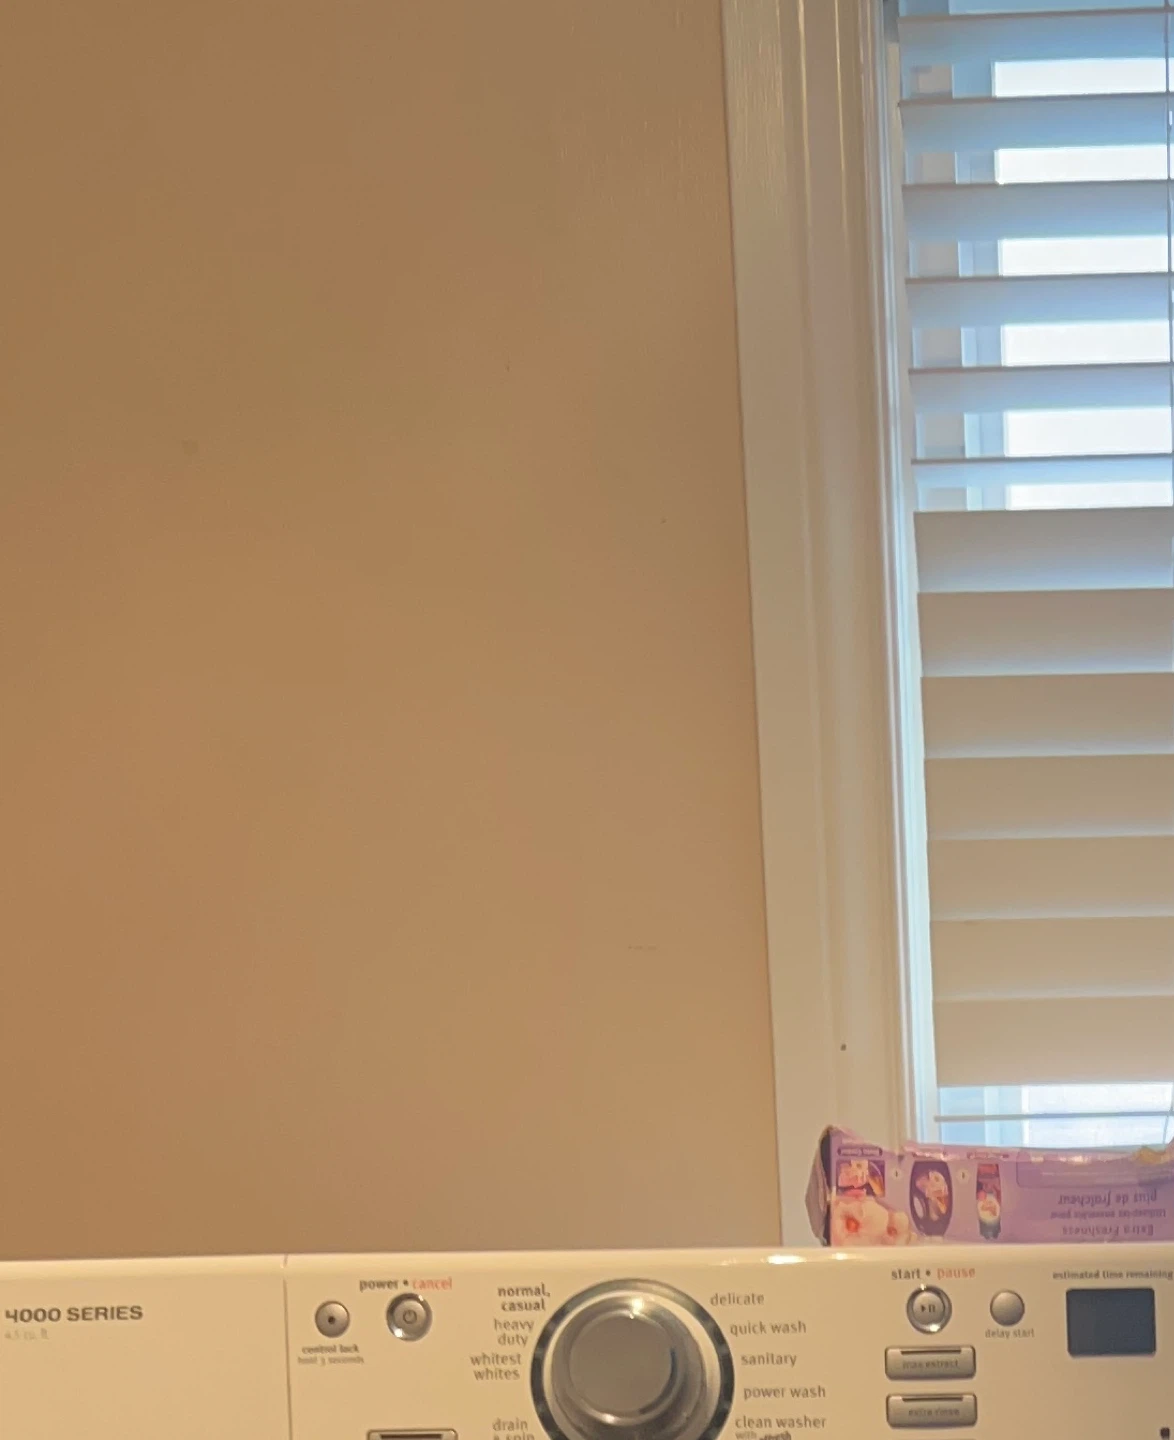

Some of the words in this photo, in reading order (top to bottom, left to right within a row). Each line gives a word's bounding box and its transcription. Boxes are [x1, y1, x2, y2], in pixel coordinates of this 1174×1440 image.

[891, 1268, 921, 1280] start
[936, 1268, 976, 1281] pause
[1052, 1270, 1100, 1280] estimated
[1102, 1270, 1123, 1279] time
[1126, 1269, 1174, 1280] remaining
[359, 1279, 399, 1293] power
[412, 1276, 453, 1290] cancel
[498, 1283, 551, 1297] normal,
[501, 1298, 546, 1312] casual
[710, 1293, 765, 1306] delicate
[5, 1307, 62, 1323] 4000
[66, 1305, 144, 1322] SERIES
[494, 1319, 534, 1333] heavy
[729, 1321, 767, 1337] quick
[770, 1321, 807, 1334] wash
[497, 1333, 528, 1348] duty
[985, 1328, 1010, 1340] delay
[1013, 1328, 1035, 1339] start
[301, 1345, 336, 1355] control
[339, 1344, 360, 1354] lock
[470, 1352, 522, 1367] whitest
[741, 1352, 797, 1368] sanitary
[473, 1368, 521, 1381] whites
[743, 1387, 786, 1401] power
[790, 1385, 827, 1398] wash
[492, 1418, 528, 1432] drain
[735, 1415, 772, 1429] clean
[776, 1415, 827, 1429] washer
